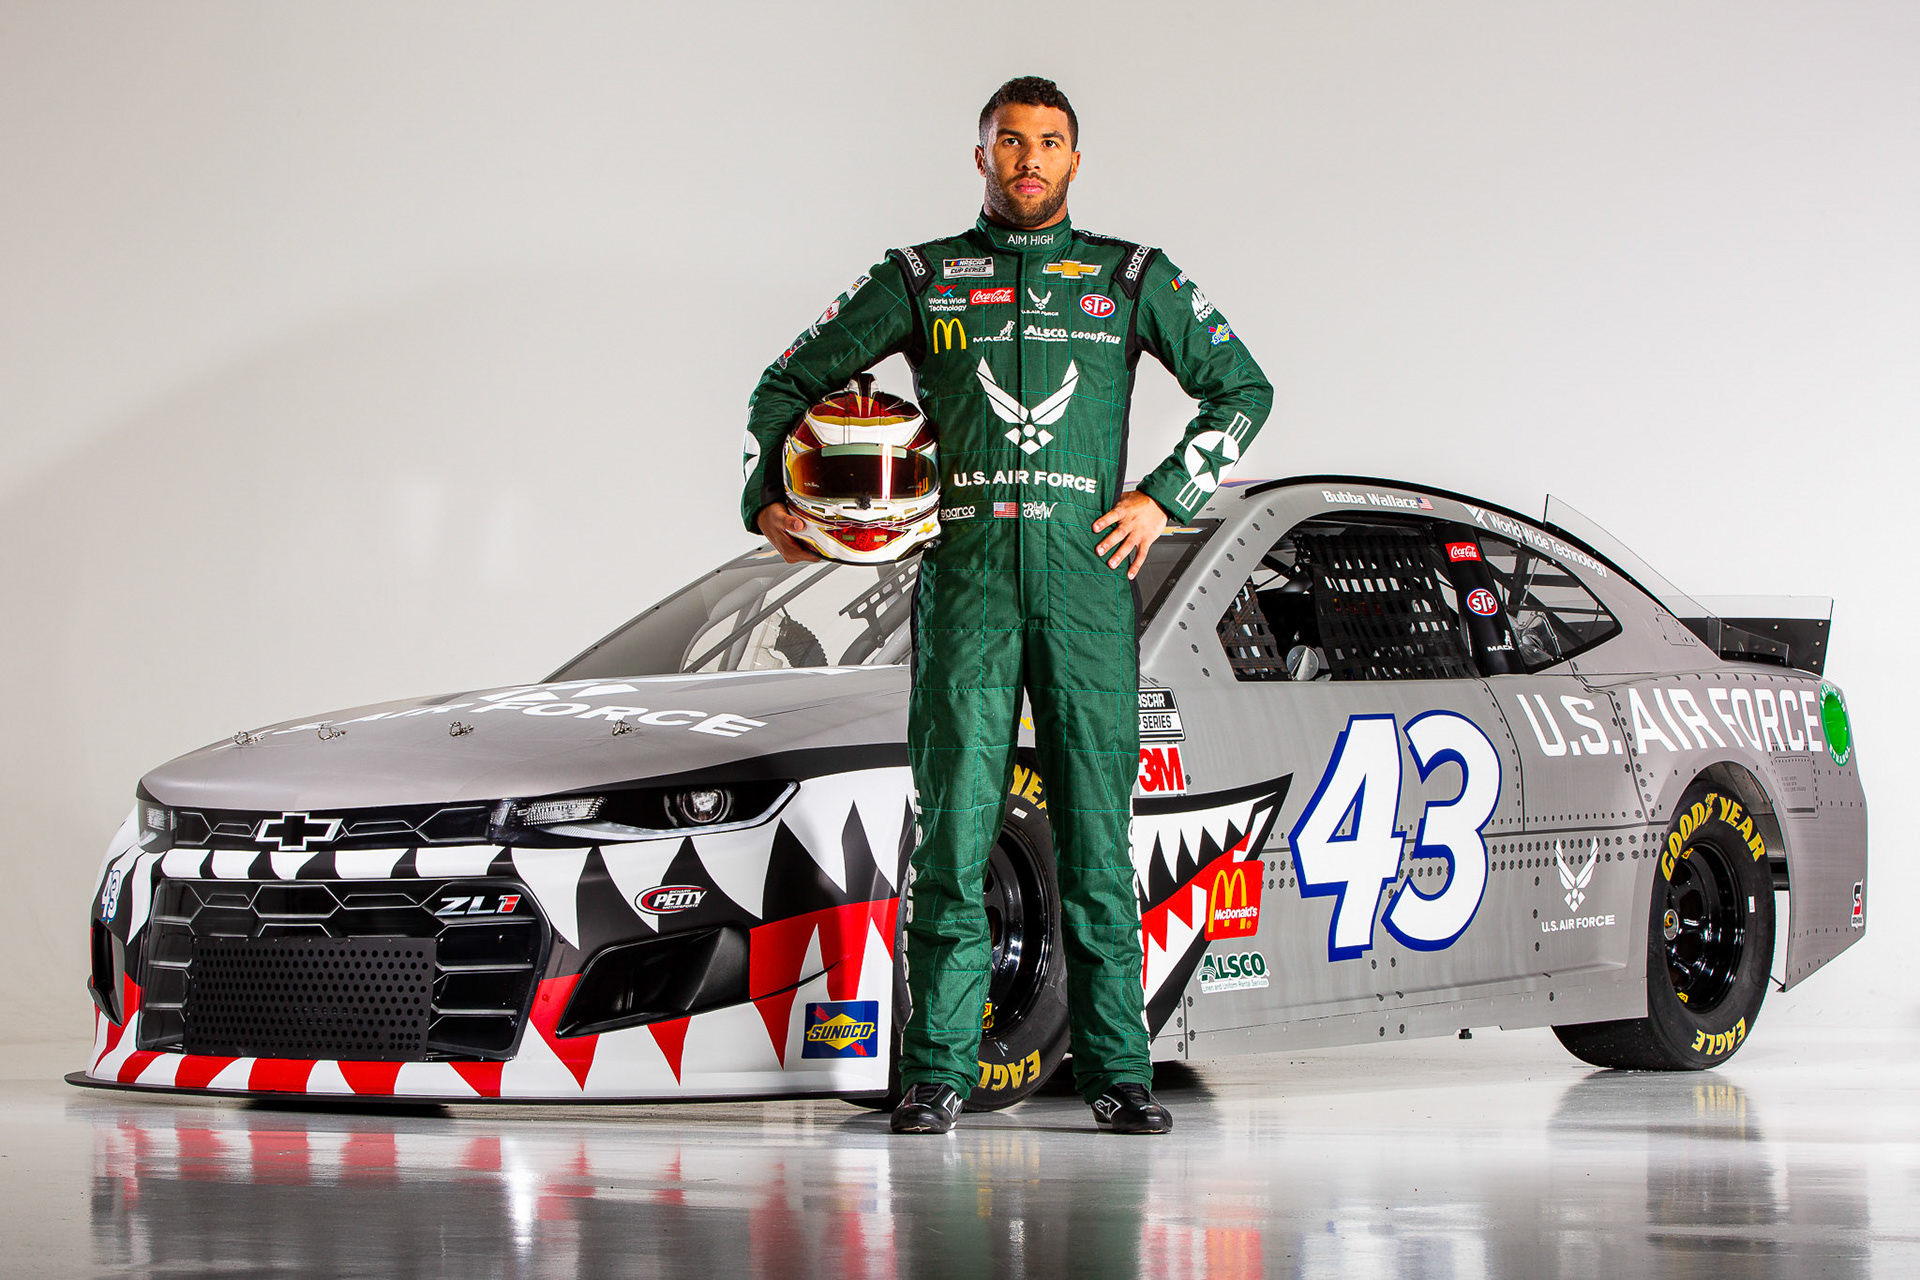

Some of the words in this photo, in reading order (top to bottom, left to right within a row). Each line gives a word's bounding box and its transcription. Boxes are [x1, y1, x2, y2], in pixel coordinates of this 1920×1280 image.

[1007, 234, 1028, 246] AIM
[1030, 233, 1054, 246] HIGH
[901, 247, 926, 276] parco
[928, 297, 948, 305] World
[928, 304, 967, 312] Technology
[1084, 296, 1112, 314] STP
[1070, 331, 1122, 344] GOODYEAR
[953, 471, 991, 487] U.S.
[992, 470, 1030, 485] AIR
[1033, 470, 1097, 494] FORCE
[1321, 490, 1367, 505] Bubba
[1366, 493, 1418, 509] Wallace
[1487, 513, 1522, 539] World
[1521, 527, 1550, 550] Wide
[1547, 538, 1607, 578] Technology
[1471, 591, 1496, 612] STP
[1487, 645, 1515, 653] MACK
[1138, 692, 1166, 708] ASCAR
[468, 700, 768, 738] FORCE
[1142, 715, 1172, 729] SERIES
[1516, 690, 1624, 757] U.S.
[1628, 688, 1727, 754] AIR
[1707, 687, 1823, 752] FORCE
[1138, 747, 1186, 793] 3M
[1288, 709, 1503, 963] 43
[435, 894, 521, 915] ZL1
[653, 890, 708, 908] PETTY
[1213, 905, 1258, 921] McDonald's
[1541, 920, 1559, 932] U.S.
[1559, 919, 1576, 931] AIR
[1576, 915, 1616, 929] FORCE
[1199, 953, 1266, 982] ALSCO
[809, 1023, 873, 1042] SUNOCO
[1691, 1026, 1747, 1056] EAGLE
[977, 1048, 1041, 1092] EAGL
